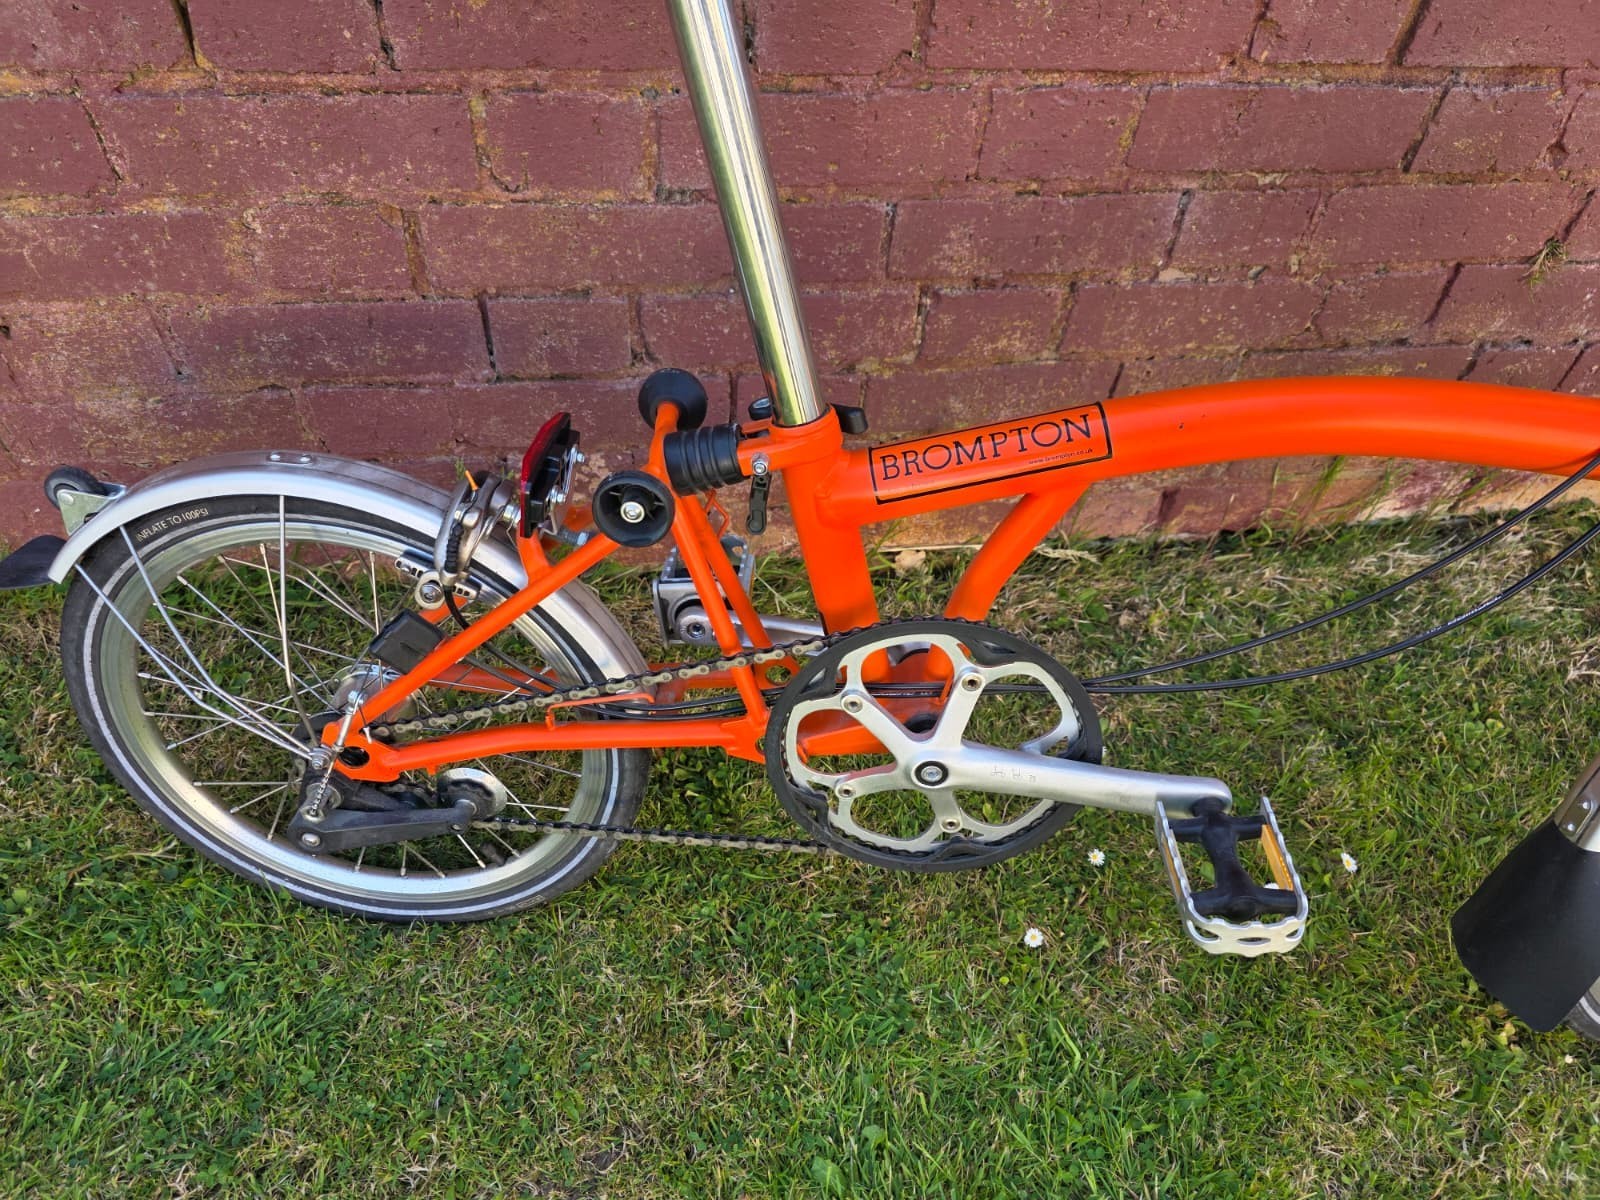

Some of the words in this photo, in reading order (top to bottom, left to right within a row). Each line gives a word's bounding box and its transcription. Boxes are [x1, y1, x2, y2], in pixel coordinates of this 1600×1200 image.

[880, 414, 1091, 480] BROMPTON
[135, 520, 168, 542] INFLATE
[167, 515, 182, 525] TO
[182, 508, 209, 521] 100PSI
